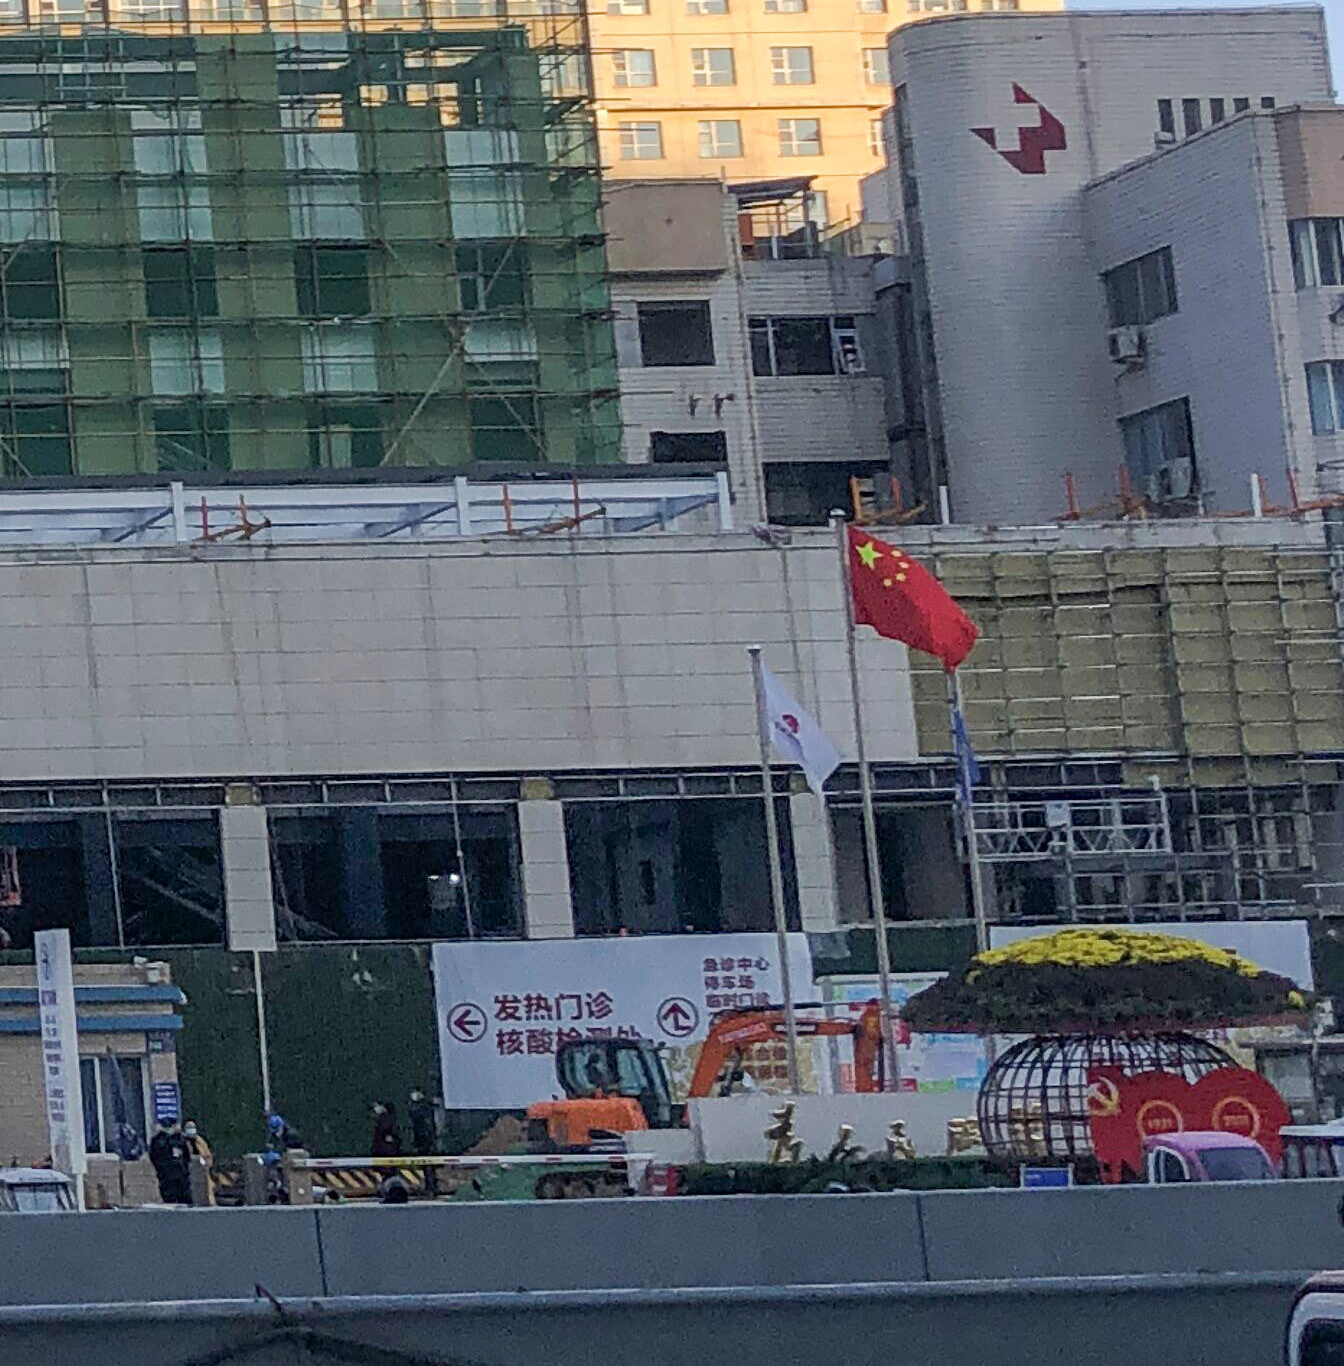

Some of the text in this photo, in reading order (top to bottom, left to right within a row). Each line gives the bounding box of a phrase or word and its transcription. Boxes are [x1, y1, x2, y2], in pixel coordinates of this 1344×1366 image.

[703, 956, 770, 972] 急诊中心
[493, 991, 613, 1021] 发热门诊
